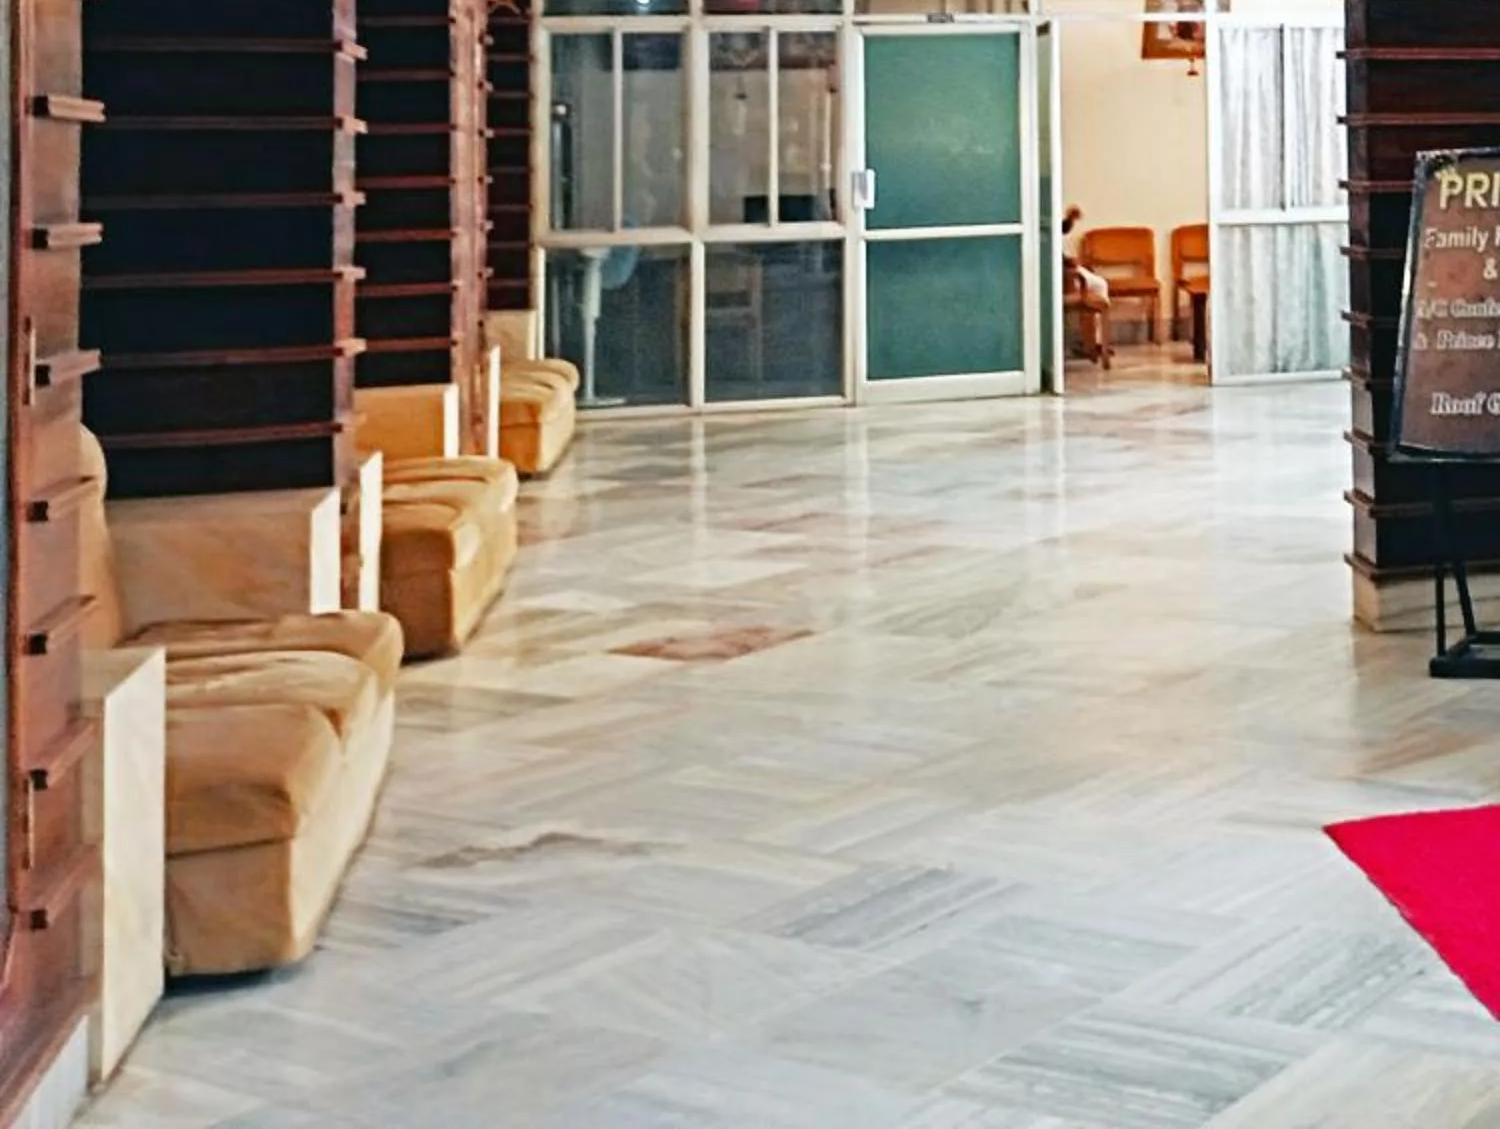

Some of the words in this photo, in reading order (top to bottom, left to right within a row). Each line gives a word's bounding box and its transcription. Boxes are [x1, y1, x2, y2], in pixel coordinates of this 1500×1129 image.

[1424, 226, 1488, 252] Family
[1482, 257, 1498, 280] &
[1430, 391, 1486, 415] Roof
